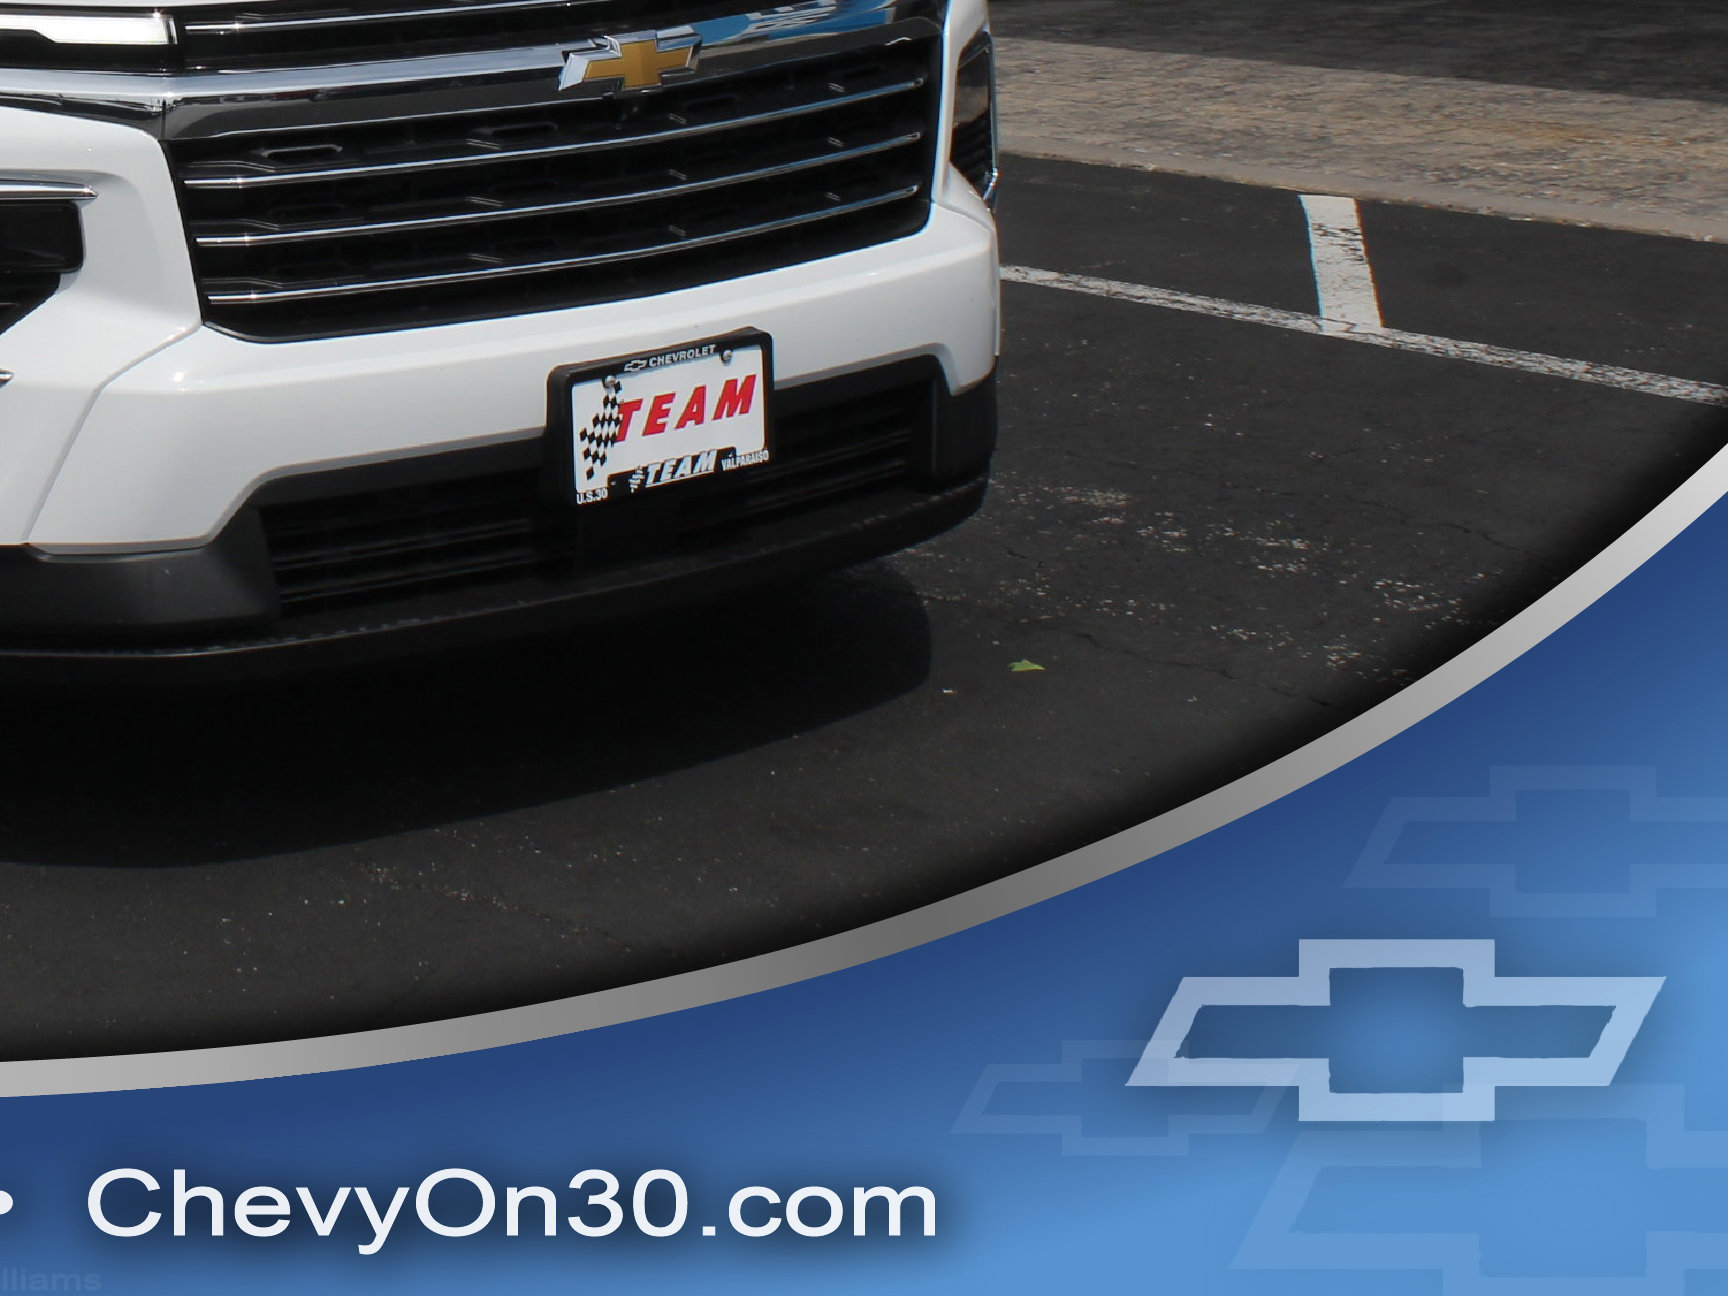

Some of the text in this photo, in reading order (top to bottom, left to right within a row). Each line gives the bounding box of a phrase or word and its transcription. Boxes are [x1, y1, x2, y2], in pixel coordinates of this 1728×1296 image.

[648, 344, 716, 367] CHEVROLET
[616, 374, 757, 443] TEAM
[644, 449, 718, 488] TEAM
[721, 449, 770, 472] VALPARAISO
